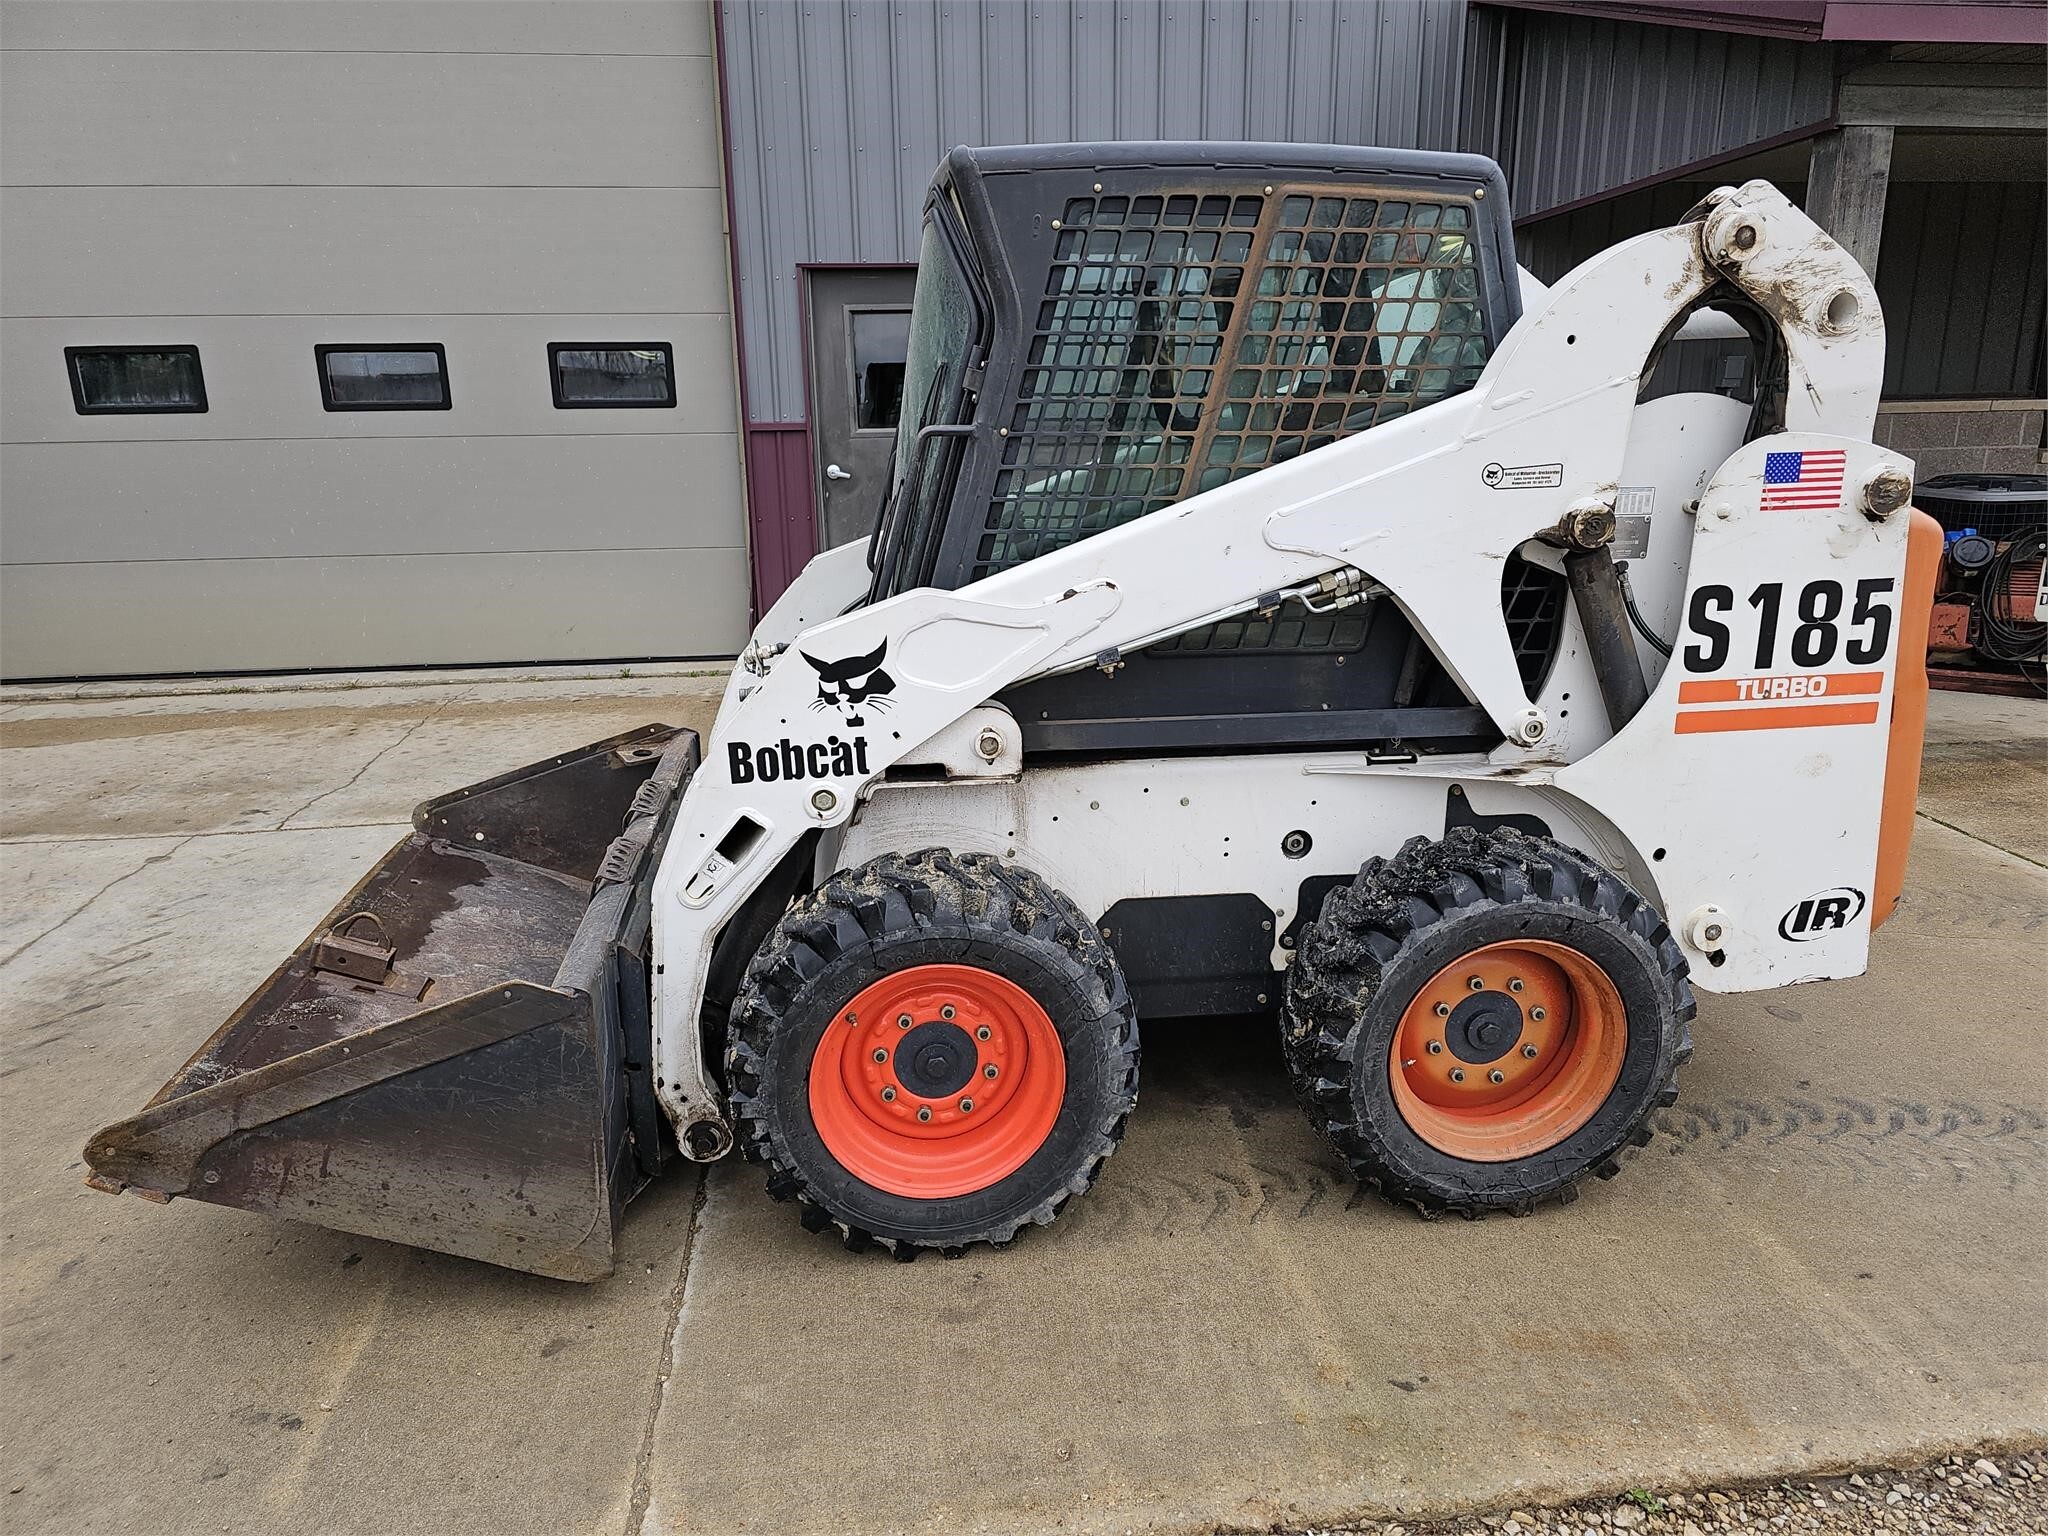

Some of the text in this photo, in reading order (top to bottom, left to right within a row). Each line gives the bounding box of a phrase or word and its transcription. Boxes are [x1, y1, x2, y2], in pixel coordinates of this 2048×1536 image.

[1684, 577, 1895, 673] S185
[1736, 676, 1828, 700] TURBO
[727, 736, 870, 784] Bobcat
[1790, 897, 1851, 934] IR
